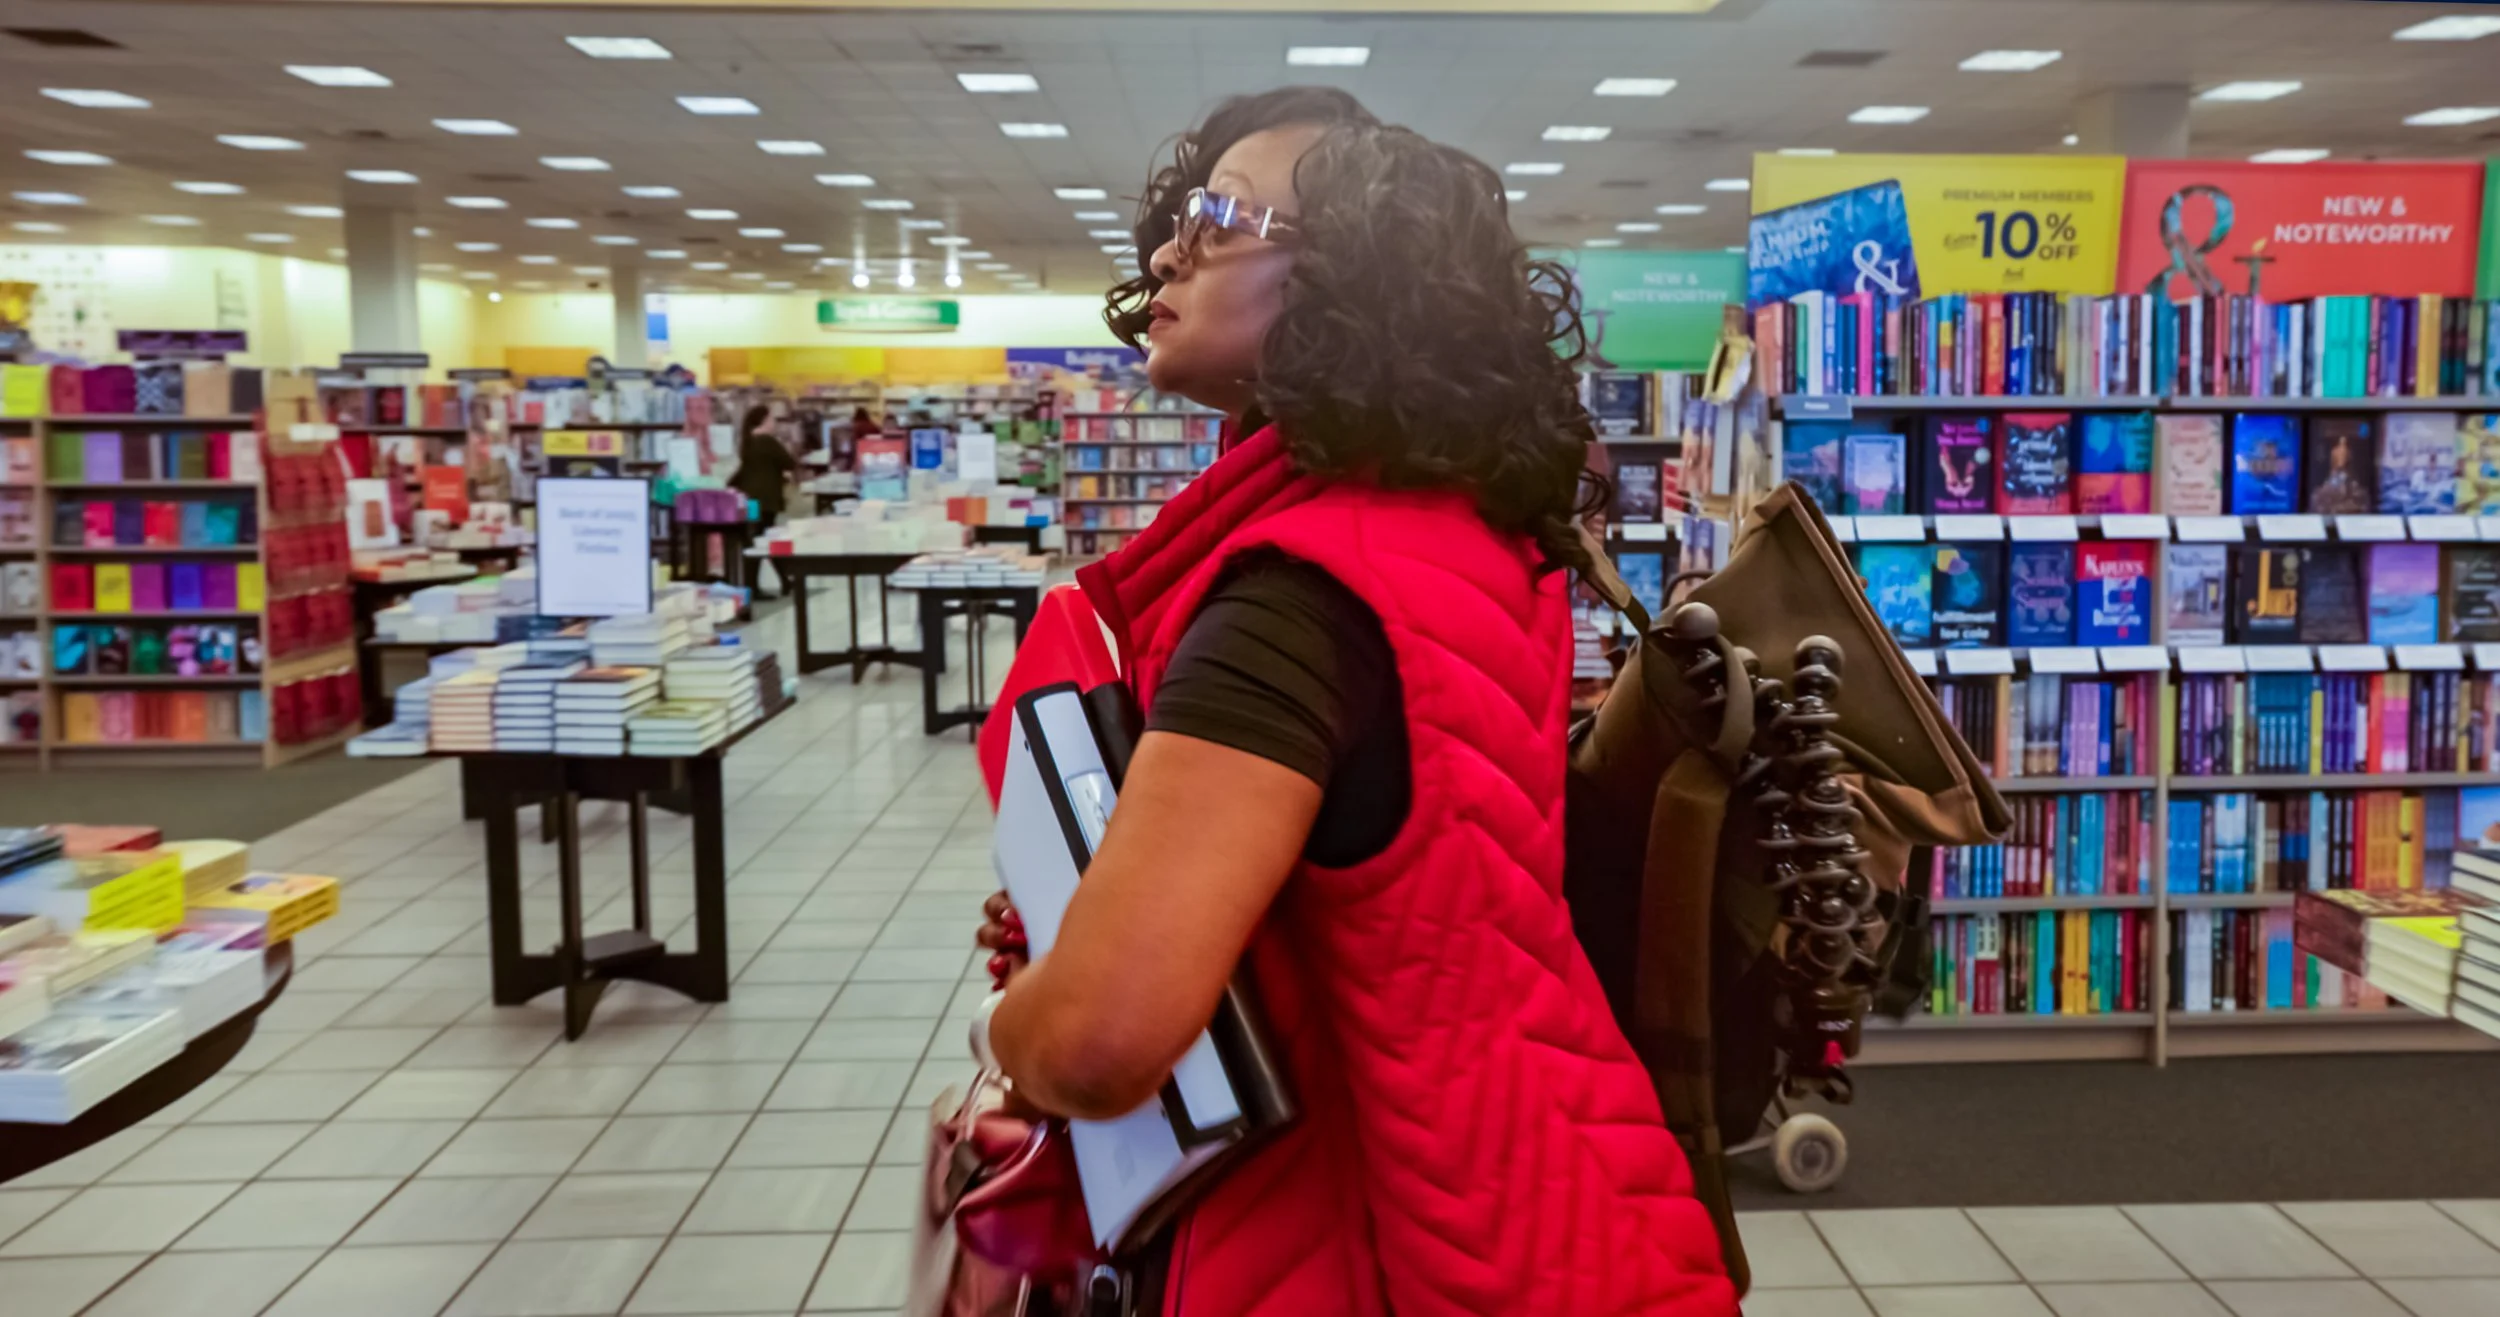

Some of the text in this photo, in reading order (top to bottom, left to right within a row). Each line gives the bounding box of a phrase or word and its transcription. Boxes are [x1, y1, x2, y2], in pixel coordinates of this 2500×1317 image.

[1943, 190, 2094, 202] PREMIUM MEMBERS
[2323, 196, 2407, 216] NEW &
[2273, 224, 2454, 243] NOTEWORTHY
[2038, 245, 2079, 260] OFF
[1643, 272, 1699, 285] NEW &
[1611, 289, 1728, 302] NOTEWORTHY
